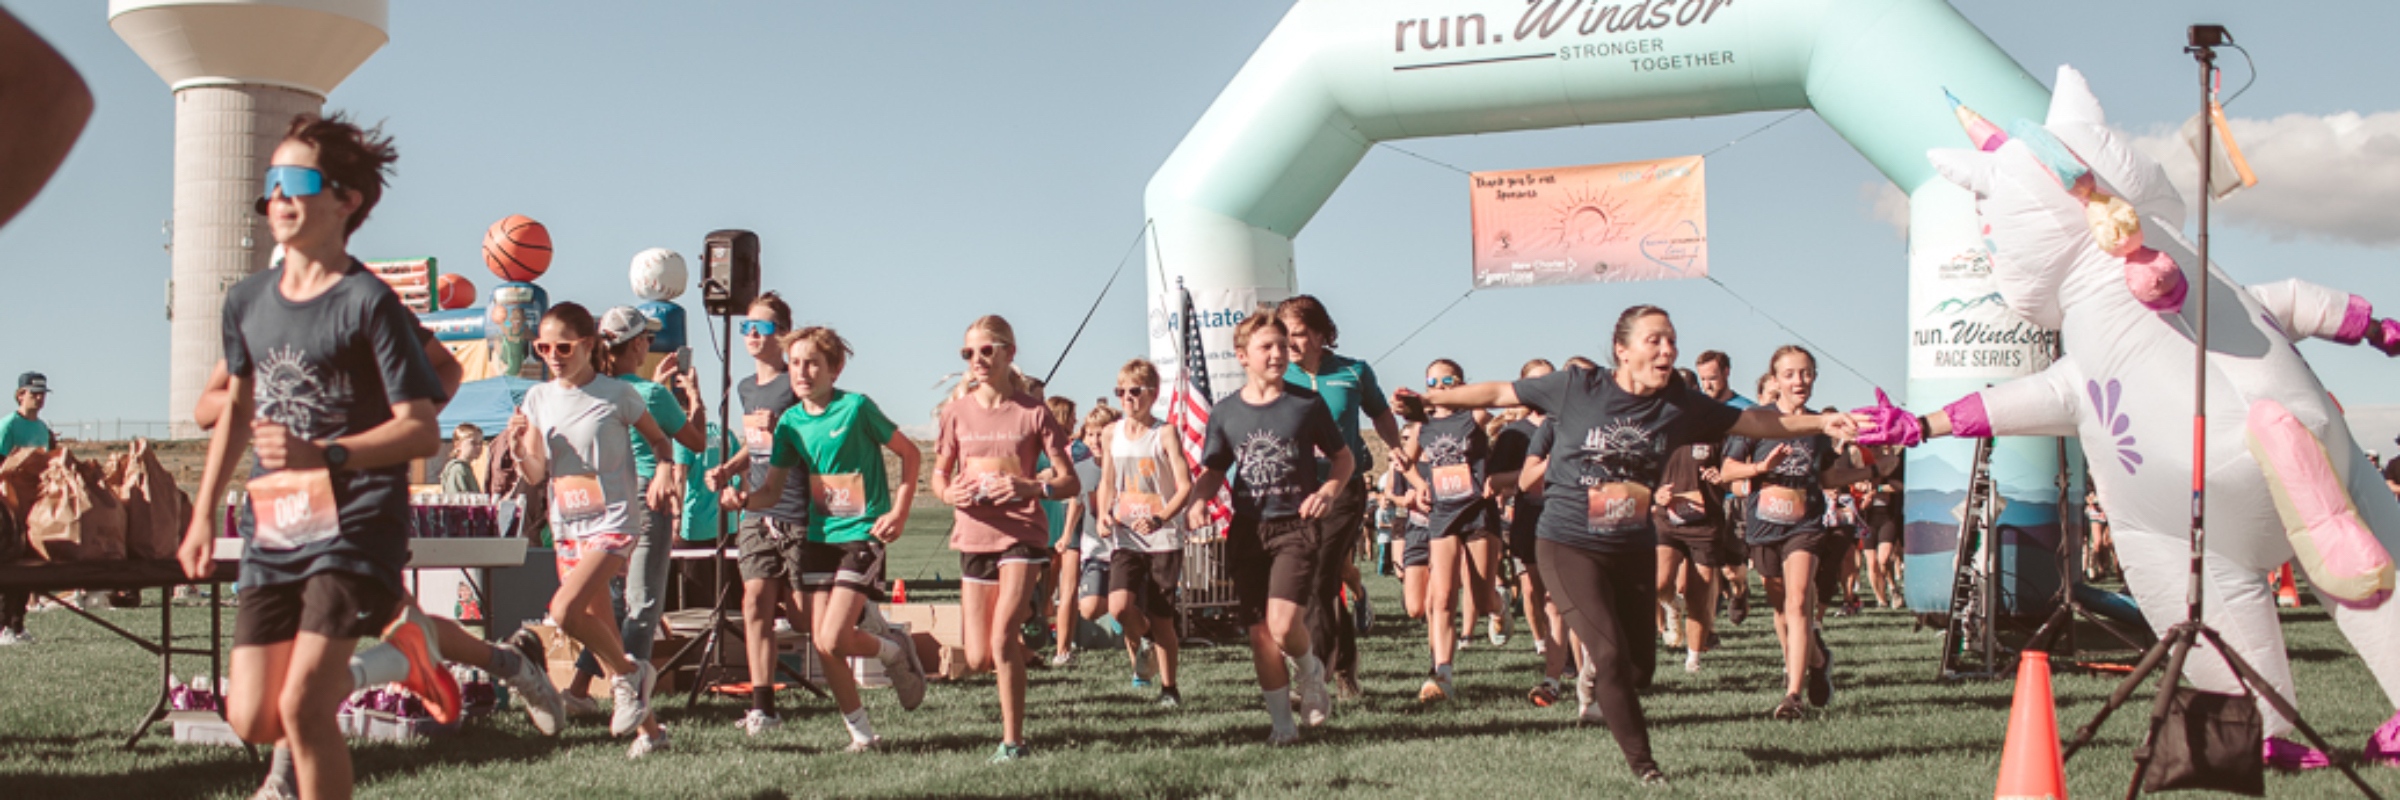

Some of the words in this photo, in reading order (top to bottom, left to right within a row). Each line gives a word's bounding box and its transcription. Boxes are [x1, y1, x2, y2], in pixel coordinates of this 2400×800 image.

[1395, 12, 1503, 53] run.
[1513, 0, 1735, 41] Windsor
[1559, 38, 1665, 61] STRONGER
[1630, 50, 1736, 73] TOGETHER
[1914, 326, 1949, 347] run.
[1934, 350, 1968, 367] RACE
[1971, 350, 2022, 367] SERIES
